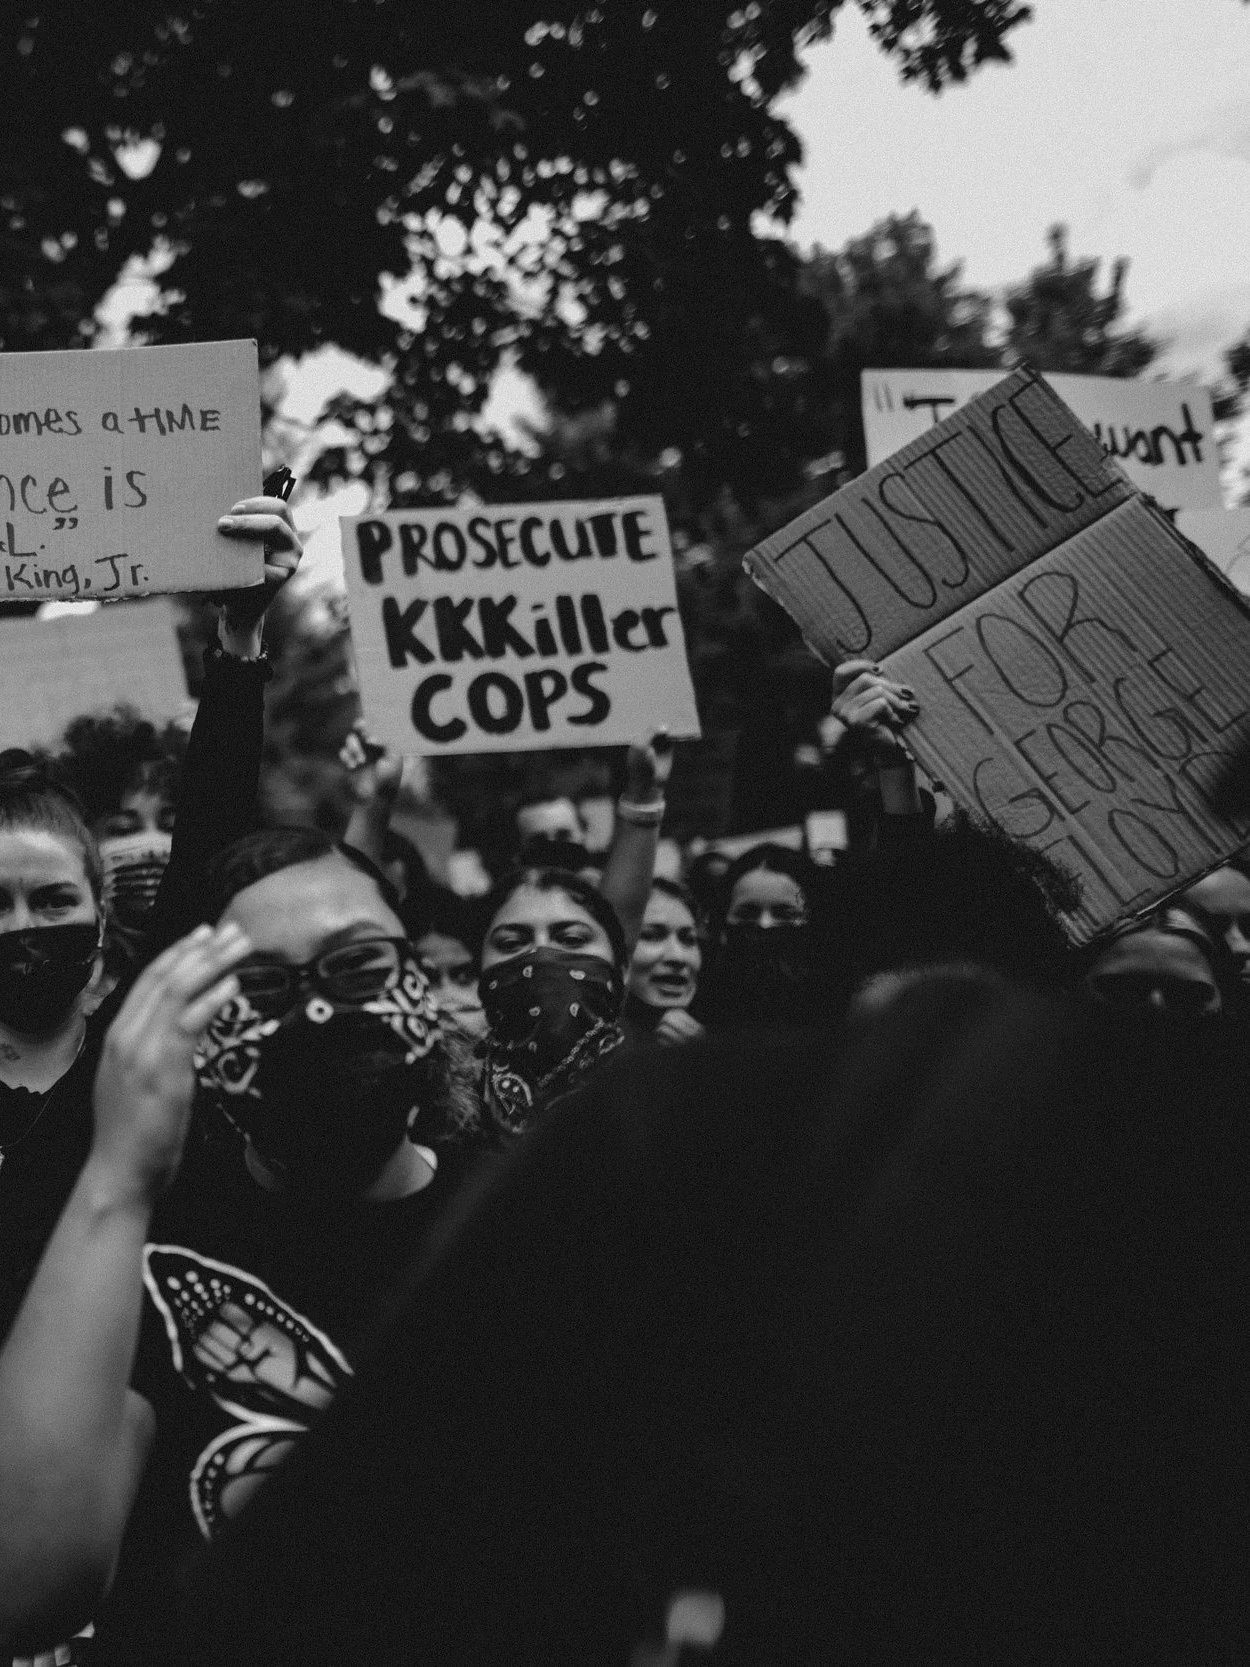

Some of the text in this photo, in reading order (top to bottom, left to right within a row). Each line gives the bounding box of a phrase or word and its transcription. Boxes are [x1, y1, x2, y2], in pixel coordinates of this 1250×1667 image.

[101, 411, 125, 435] a
[103, 466, 148, 511] is
[773, 376, 1130, 654] JUSTICE
[4, 563, 92, 595] King,
[94, 553, 150, 592] Jr.
[356, 509, 659, 586] PROSECUTE
[922, 571, 1138, 736] FOR
[410, 661, 612, 744] COPS
[972, 648, 1250, 840] GEORGE
